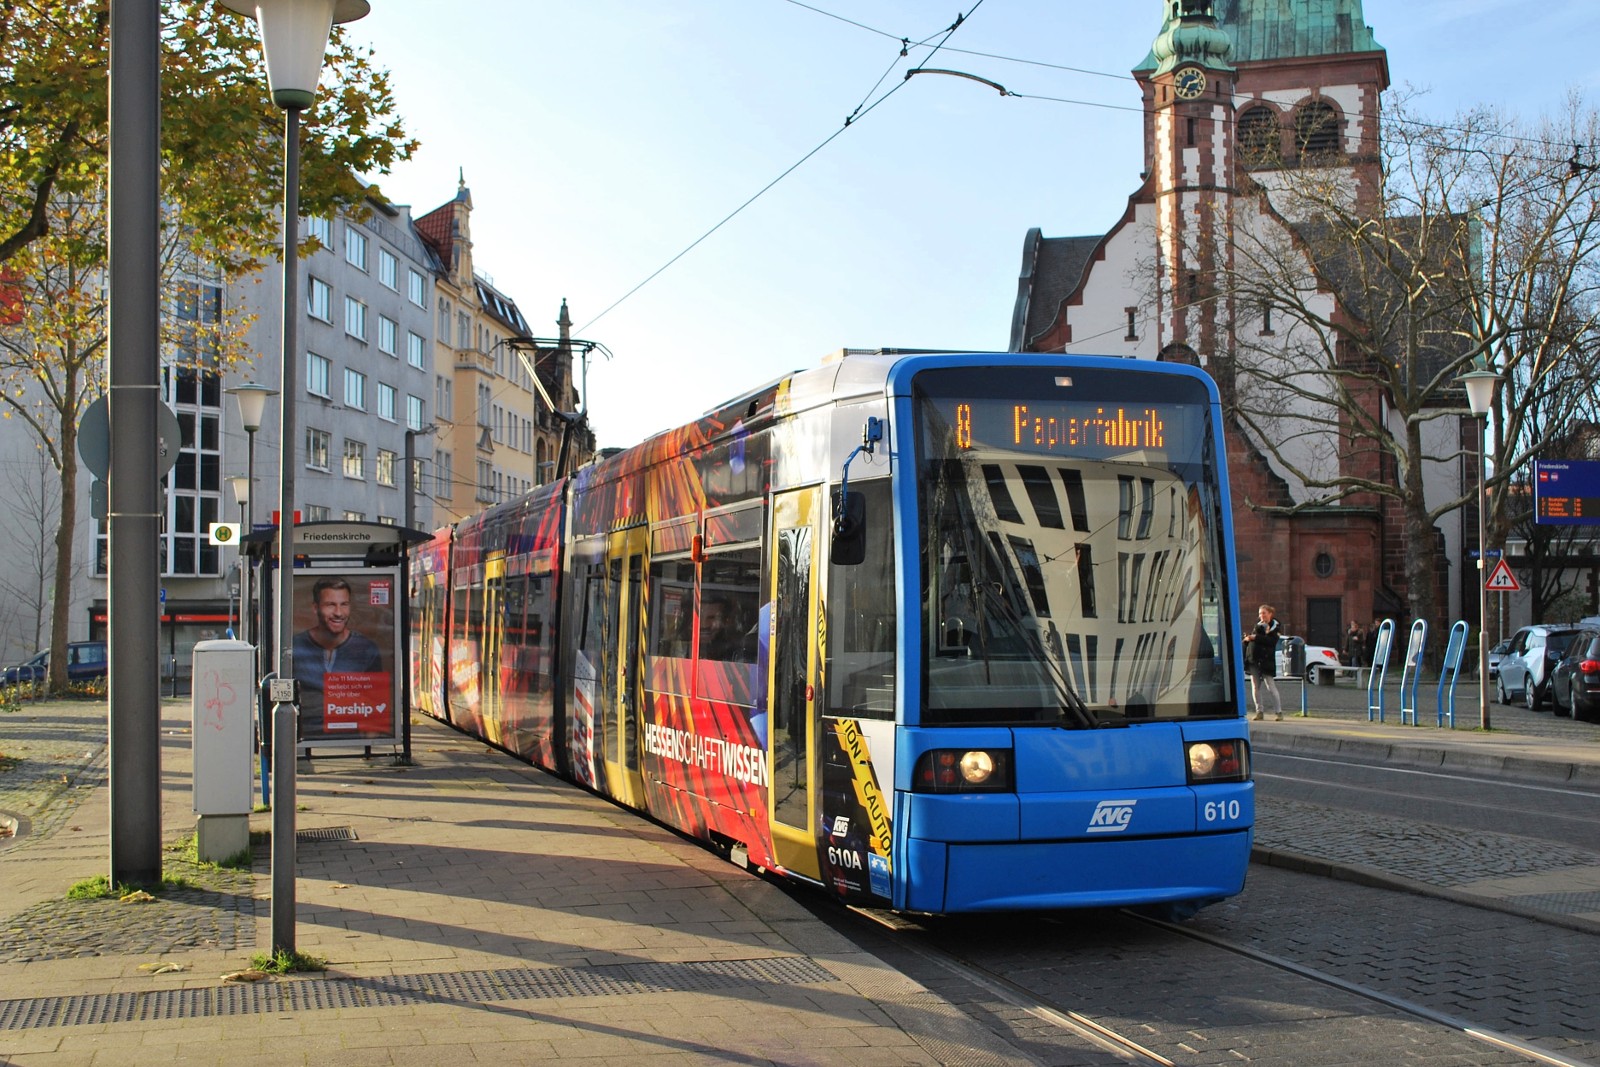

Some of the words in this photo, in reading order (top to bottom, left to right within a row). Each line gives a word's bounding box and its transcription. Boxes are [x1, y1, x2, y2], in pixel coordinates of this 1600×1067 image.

[956, 404, 971, 448] 8
[1013, 405, 1164, 449] Papierfabrik
[303, 532, 371, 541] Friedenskirche
[328, 691, 346, 699] Single
[327, 702, 373, 718] Parship
[1089, 804, 1134, 827] KVG
[1204, 800, 1240, 822] 610
[832, 818, 849, 834] KVG
[828, 846, 863, 870] 610A
